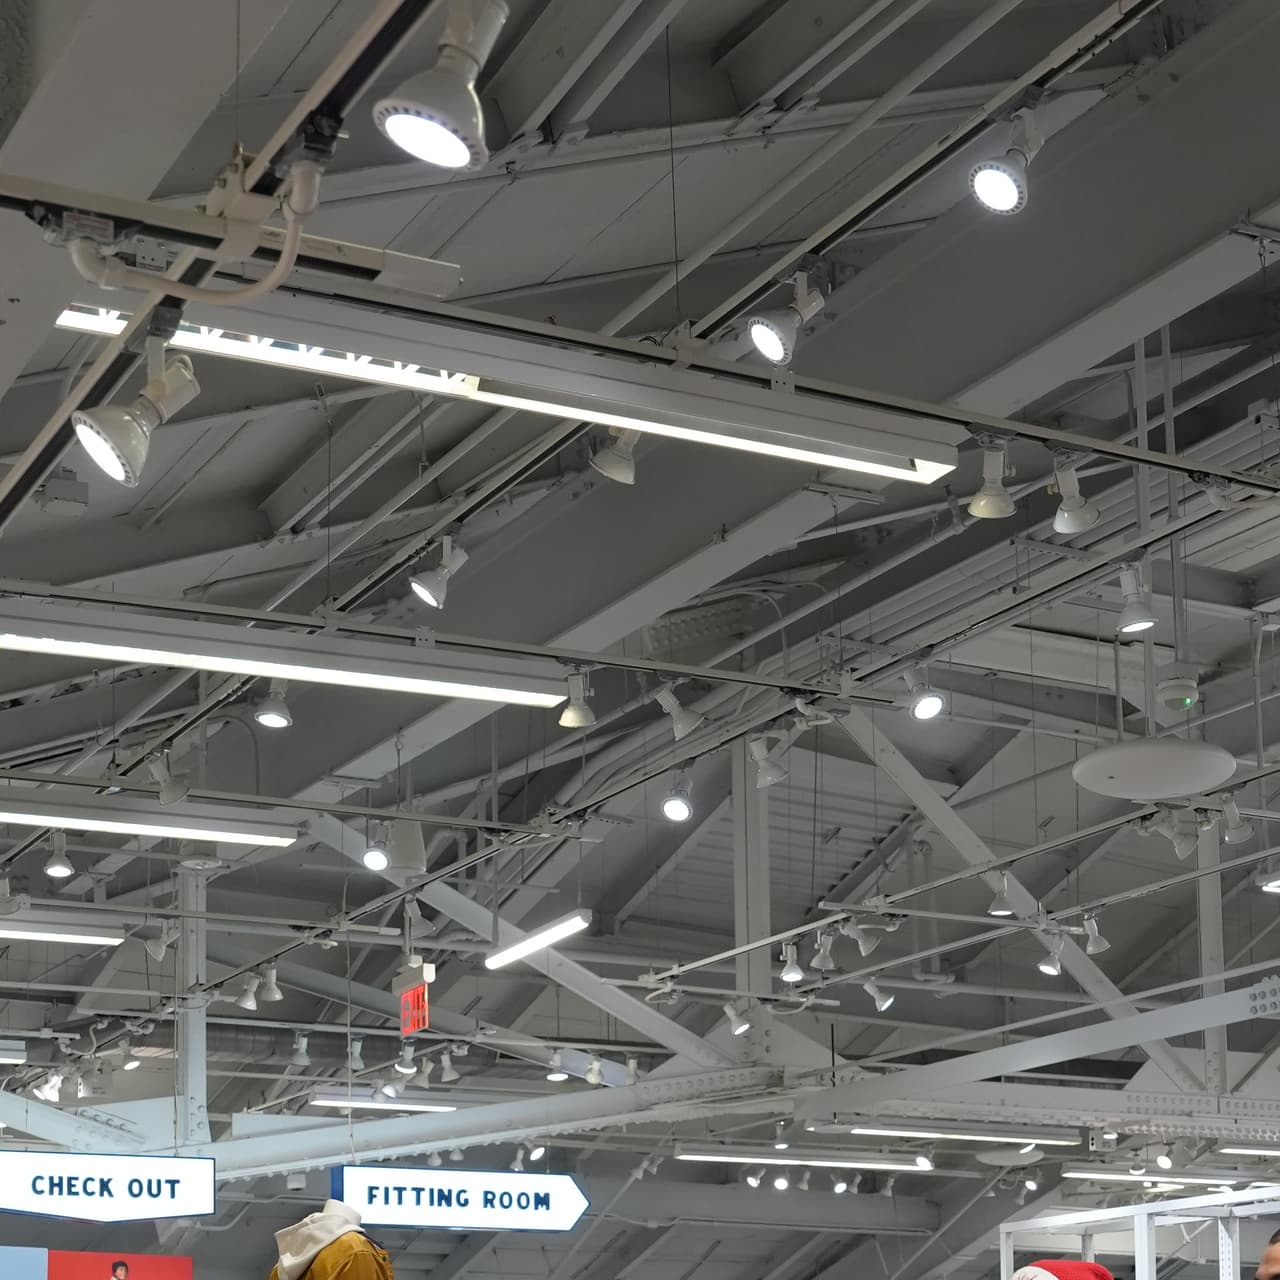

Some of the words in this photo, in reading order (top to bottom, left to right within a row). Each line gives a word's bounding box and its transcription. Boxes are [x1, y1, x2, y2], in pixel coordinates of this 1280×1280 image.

[31, 1175, 114, 1198] CHECK
[127, 1178, 181, 1199] OUT
[367, 1186, 469, 1209] FITTING
[483, 1190, 551, 1211] ROOM
